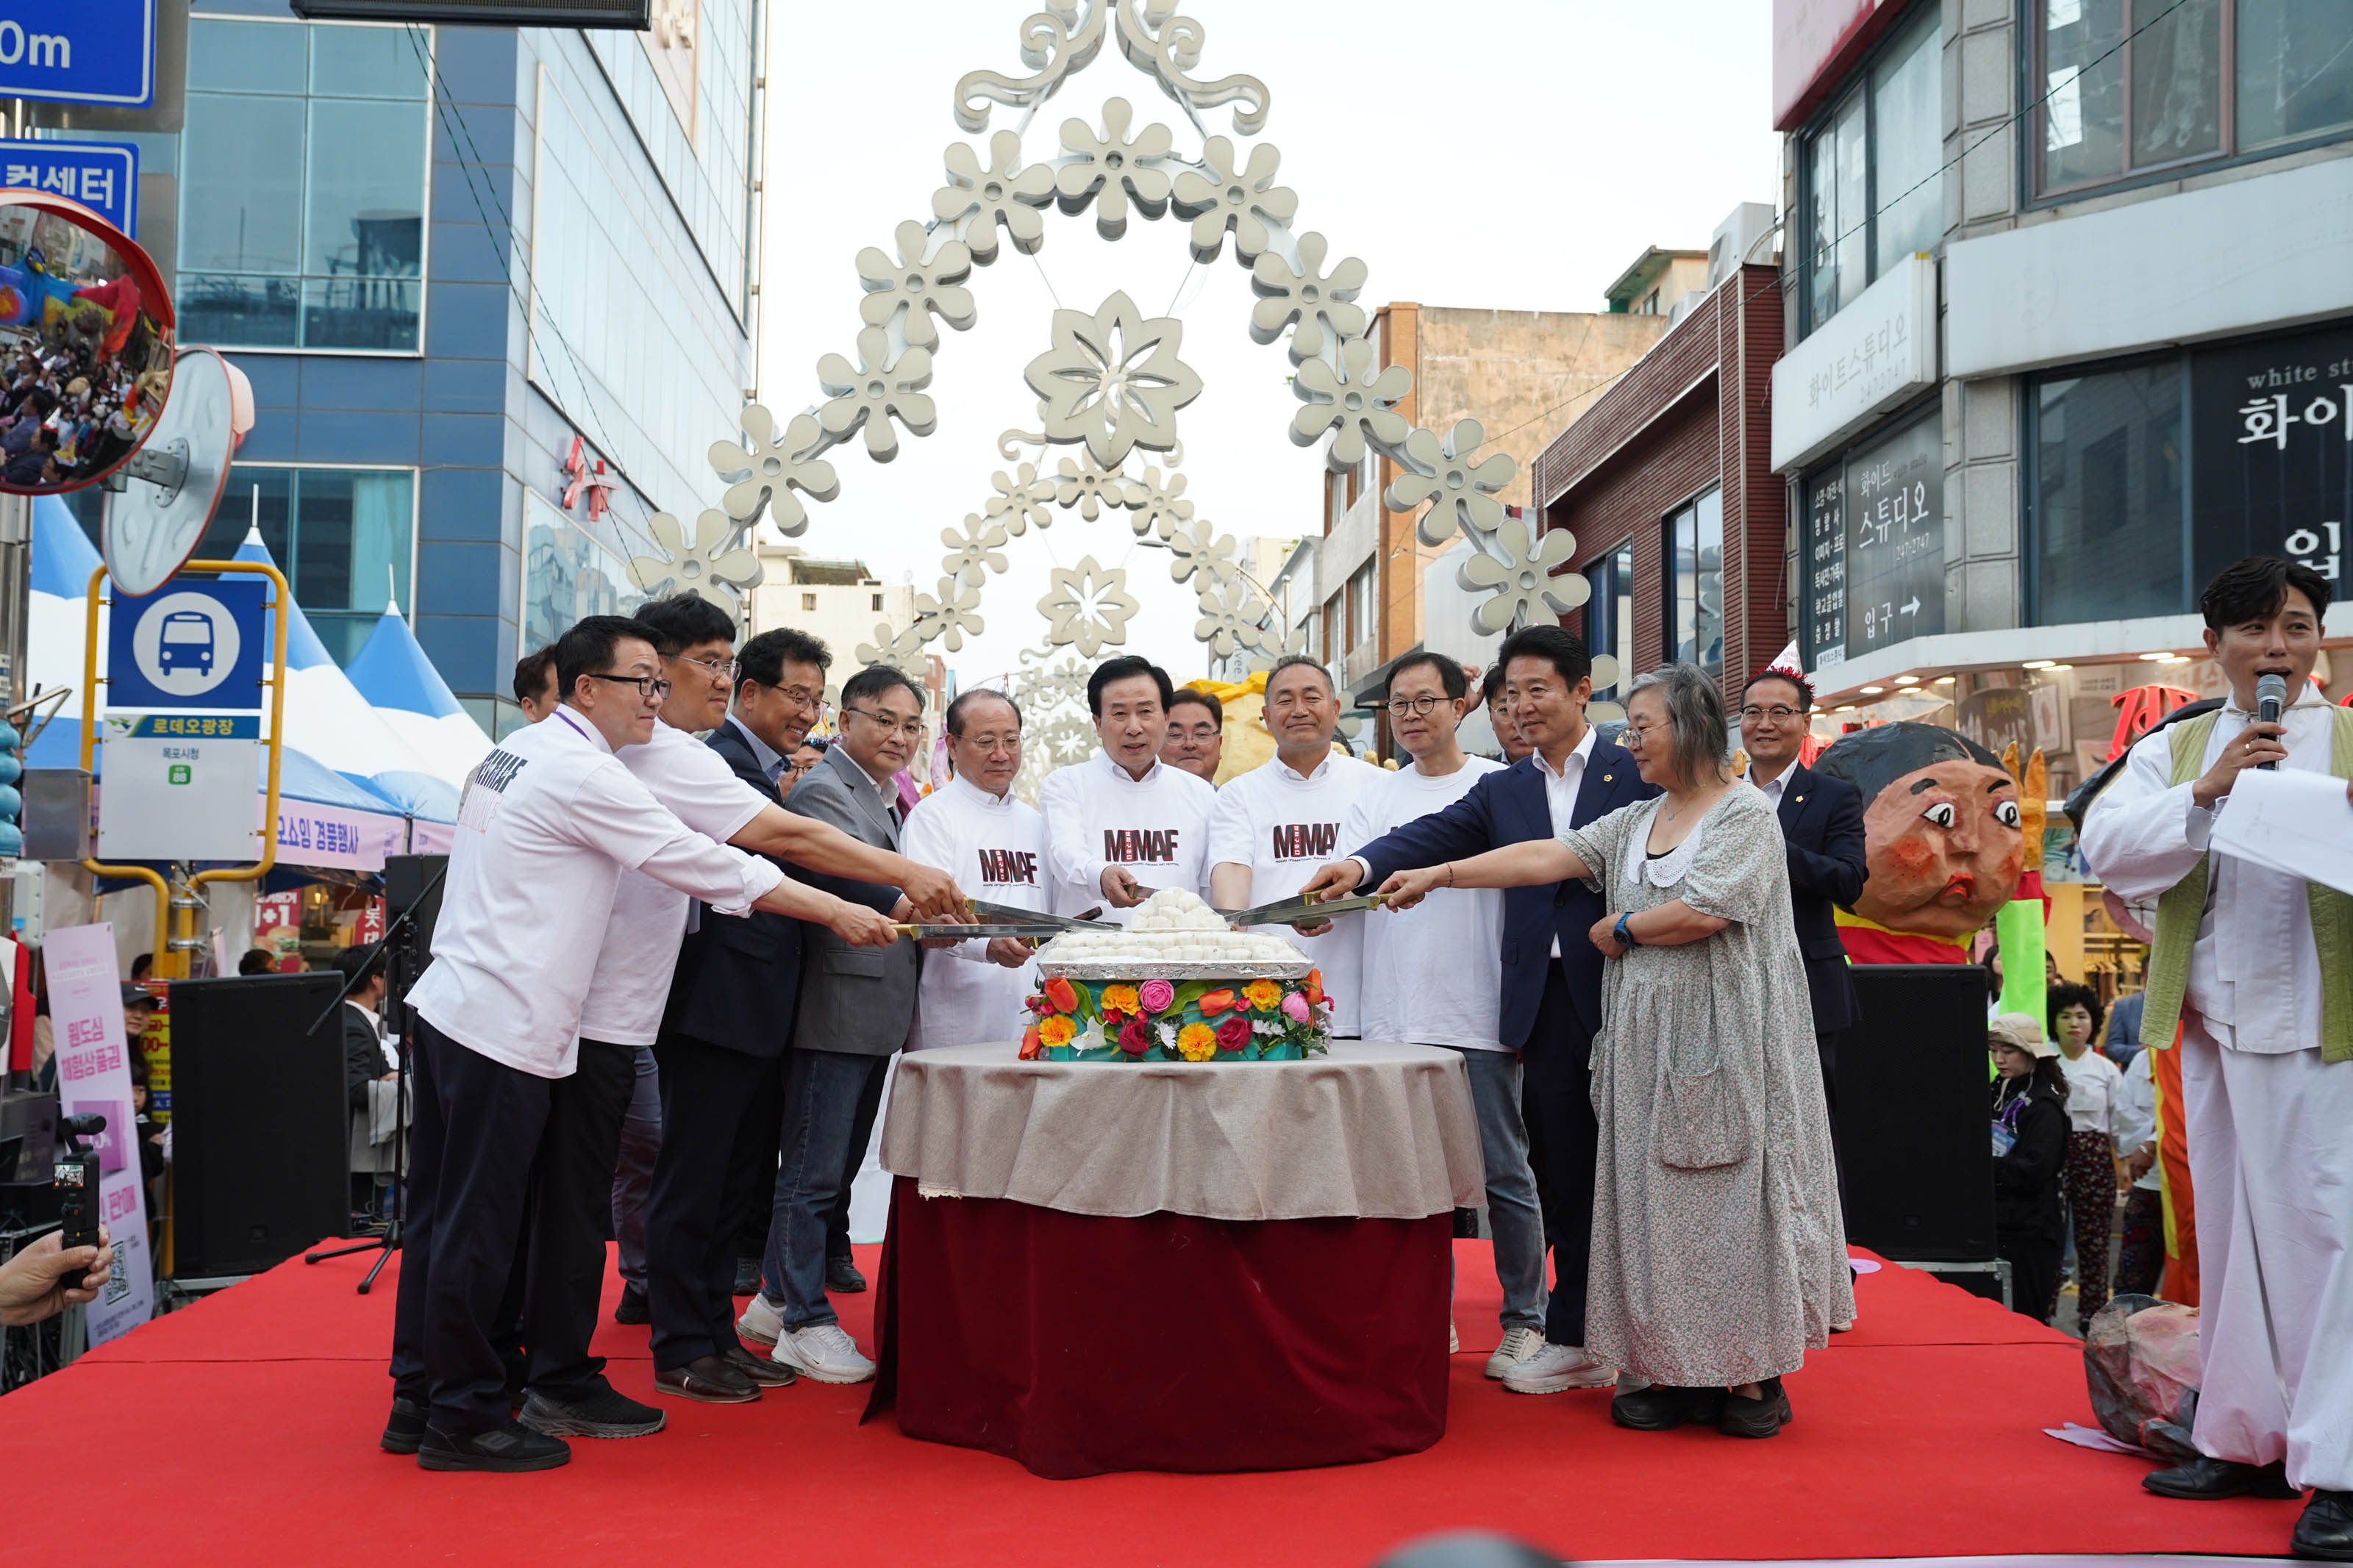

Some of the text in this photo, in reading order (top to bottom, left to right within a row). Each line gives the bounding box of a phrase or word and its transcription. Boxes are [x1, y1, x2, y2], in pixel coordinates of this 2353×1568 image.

[2247, 357, 2353, 390] white st
[1860, 460, 1893, 498] 화이트
[1859, 481, 1929, 548] 스튜디오
[152, 717, 234, 735] 로데오광장
[314, 820, 360, 855] 경품행사
[67, 1016, 104, 1048] 원도심
[61, 1044, 121, 1081] 체험상품권
[109, 1184, 138, 1222] 판매
